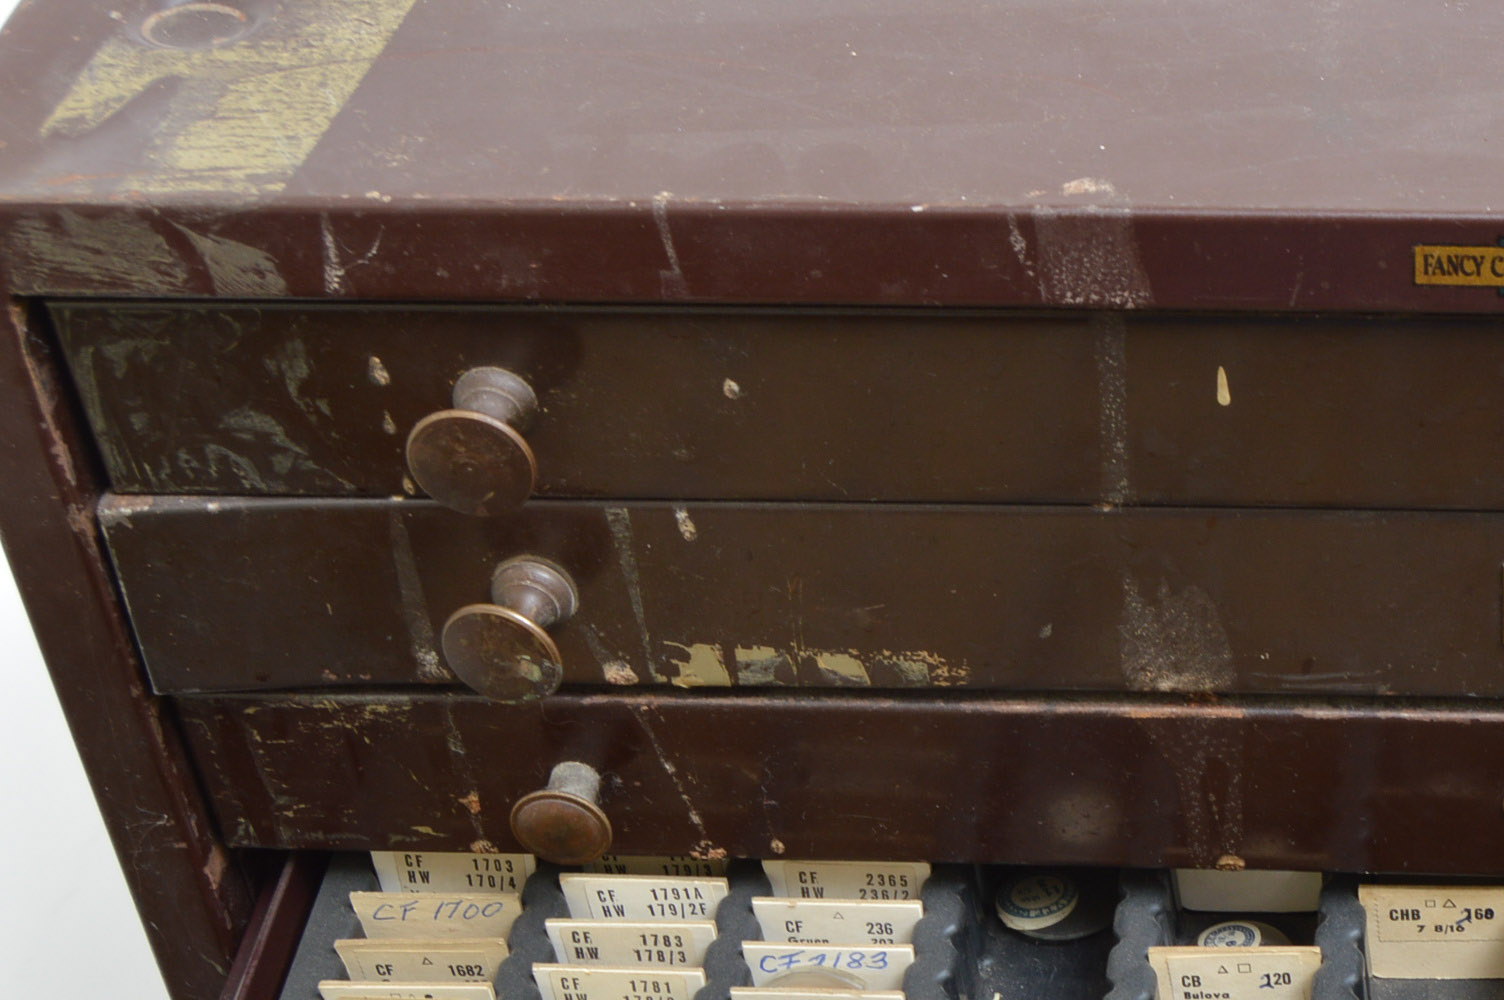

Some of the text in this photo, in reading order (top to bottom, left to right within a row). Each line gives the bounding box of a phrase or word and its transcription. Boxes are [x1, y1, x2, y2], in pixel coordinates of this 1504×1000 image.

[1423, 254, 1485, 277] FANCY
[405, 854, 514, 873] CF 1703
[799, 871, 908, 887] CF 2365
[597, 890, 615, 902] CF
[434, 900, 504, 921] 1700
[1389, 909, 1421, 921] CHB
[785, 921, 893, 935] CF 236
[572, 932, 683, 948] CF 1783
[376, 964, 483, 978] CF 1682
[561, 978, 671, 993] CF 1781
[1182, 976, 1200, 987] CB
